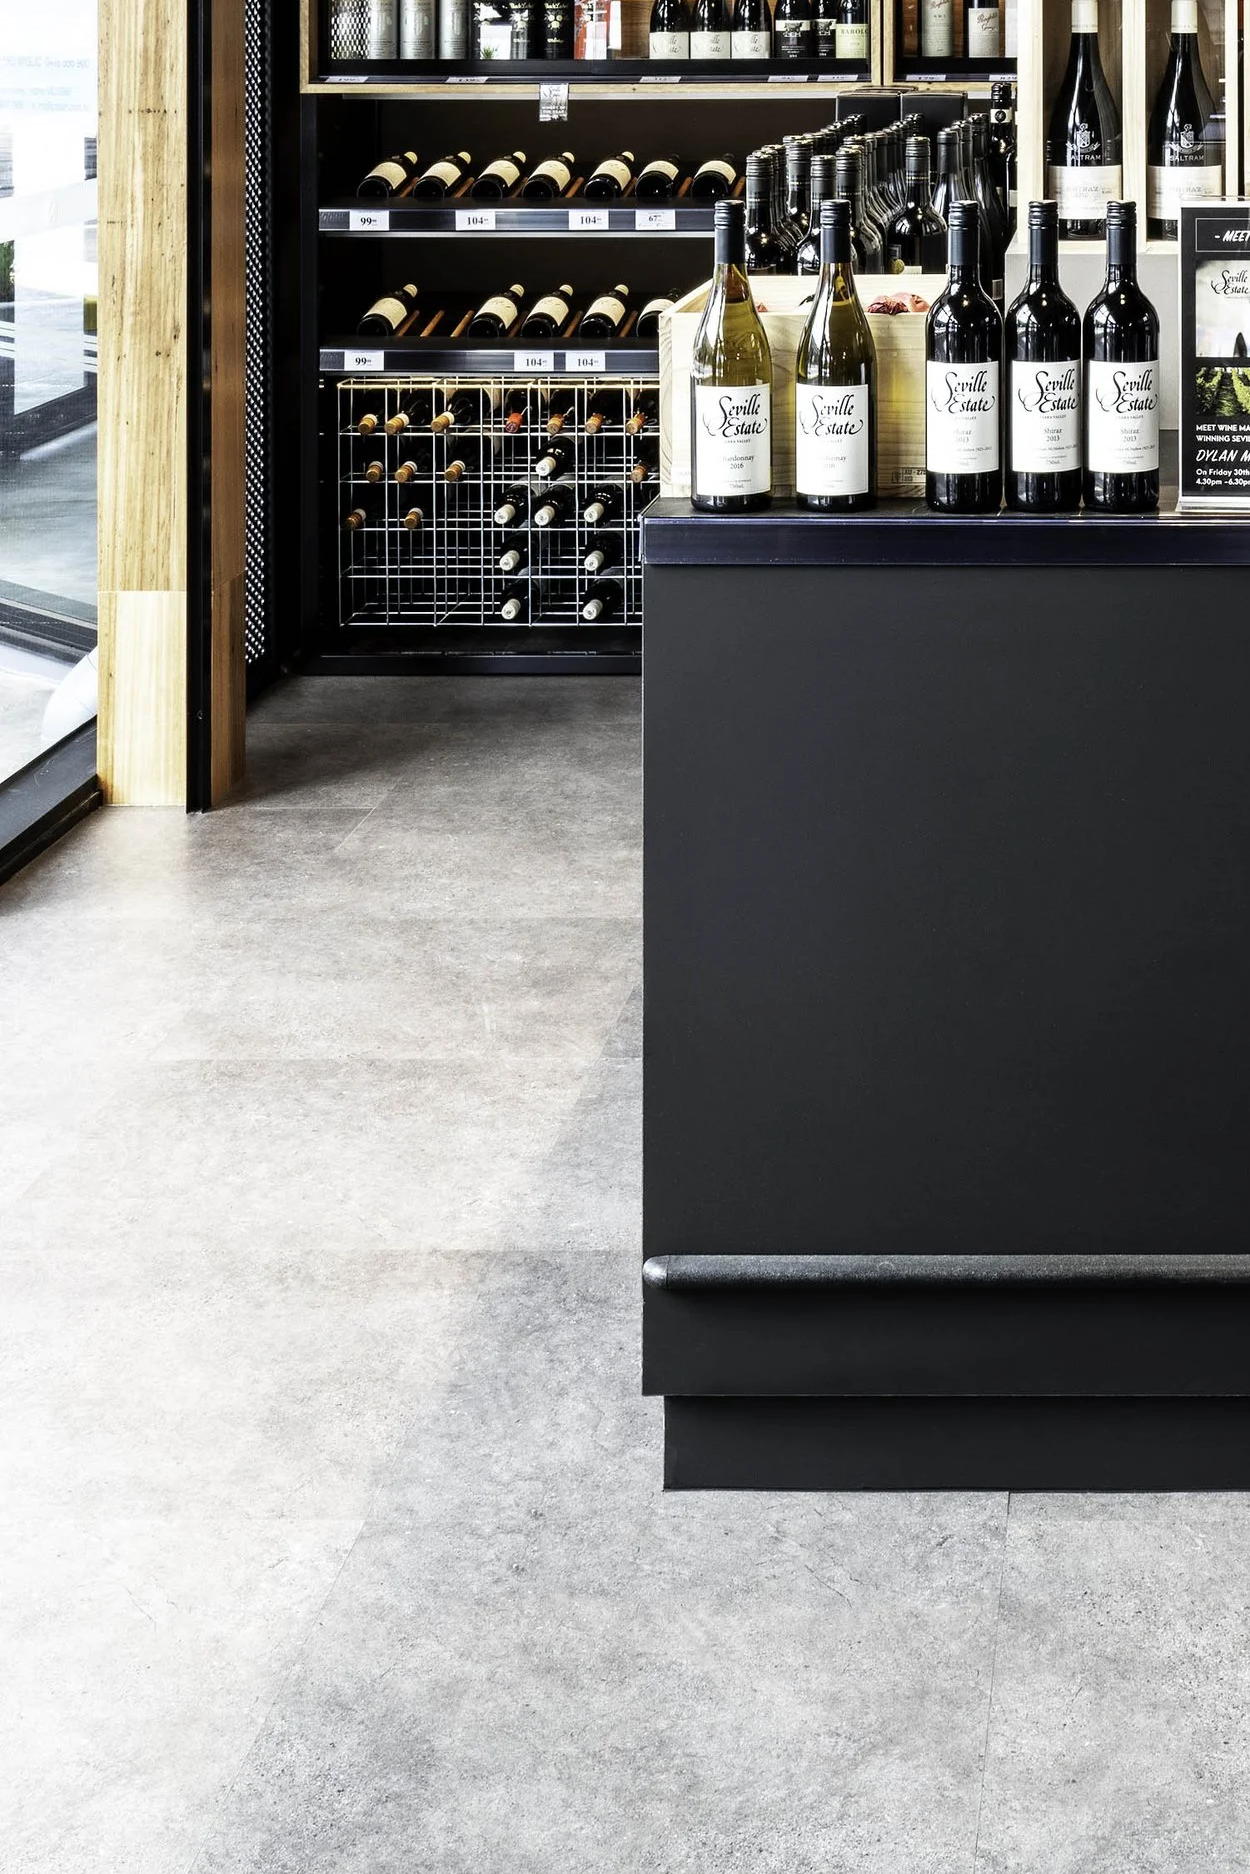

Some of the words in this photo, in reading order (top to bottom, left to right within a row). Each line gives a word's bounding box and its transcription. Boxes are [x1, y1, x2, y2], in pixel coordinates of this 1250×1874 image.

[943, 370, 988, 406] Seville
[1033, 368, 1075, 407] Seville
[1110, 368, 1153, 407] Seville
[716, 393, 761, 430] Seville
[811, 393, 855, 429] Seville
[948, 393, 996, 414] Estate
[1039, 392, 1080, 413] Estate
[1115, 392, 1158, 413] Estate
[722, 416, 768, 438] Estate
[814, 416, 864, 437] Estate
[1196, 424, 1216, 432] MEET
[1217, 424, 1237, 432] WINE
[1196, 435, 1230, 443] WINNING
[1195, 449, 1238, 462] DYLAN
[1195, 478, 1222, 487] 4.30pm
[1196, 468, 1207, 476] On
[1208, 468, 1232, 478] Friday
[1233, 468, 1250, 476] 30th
